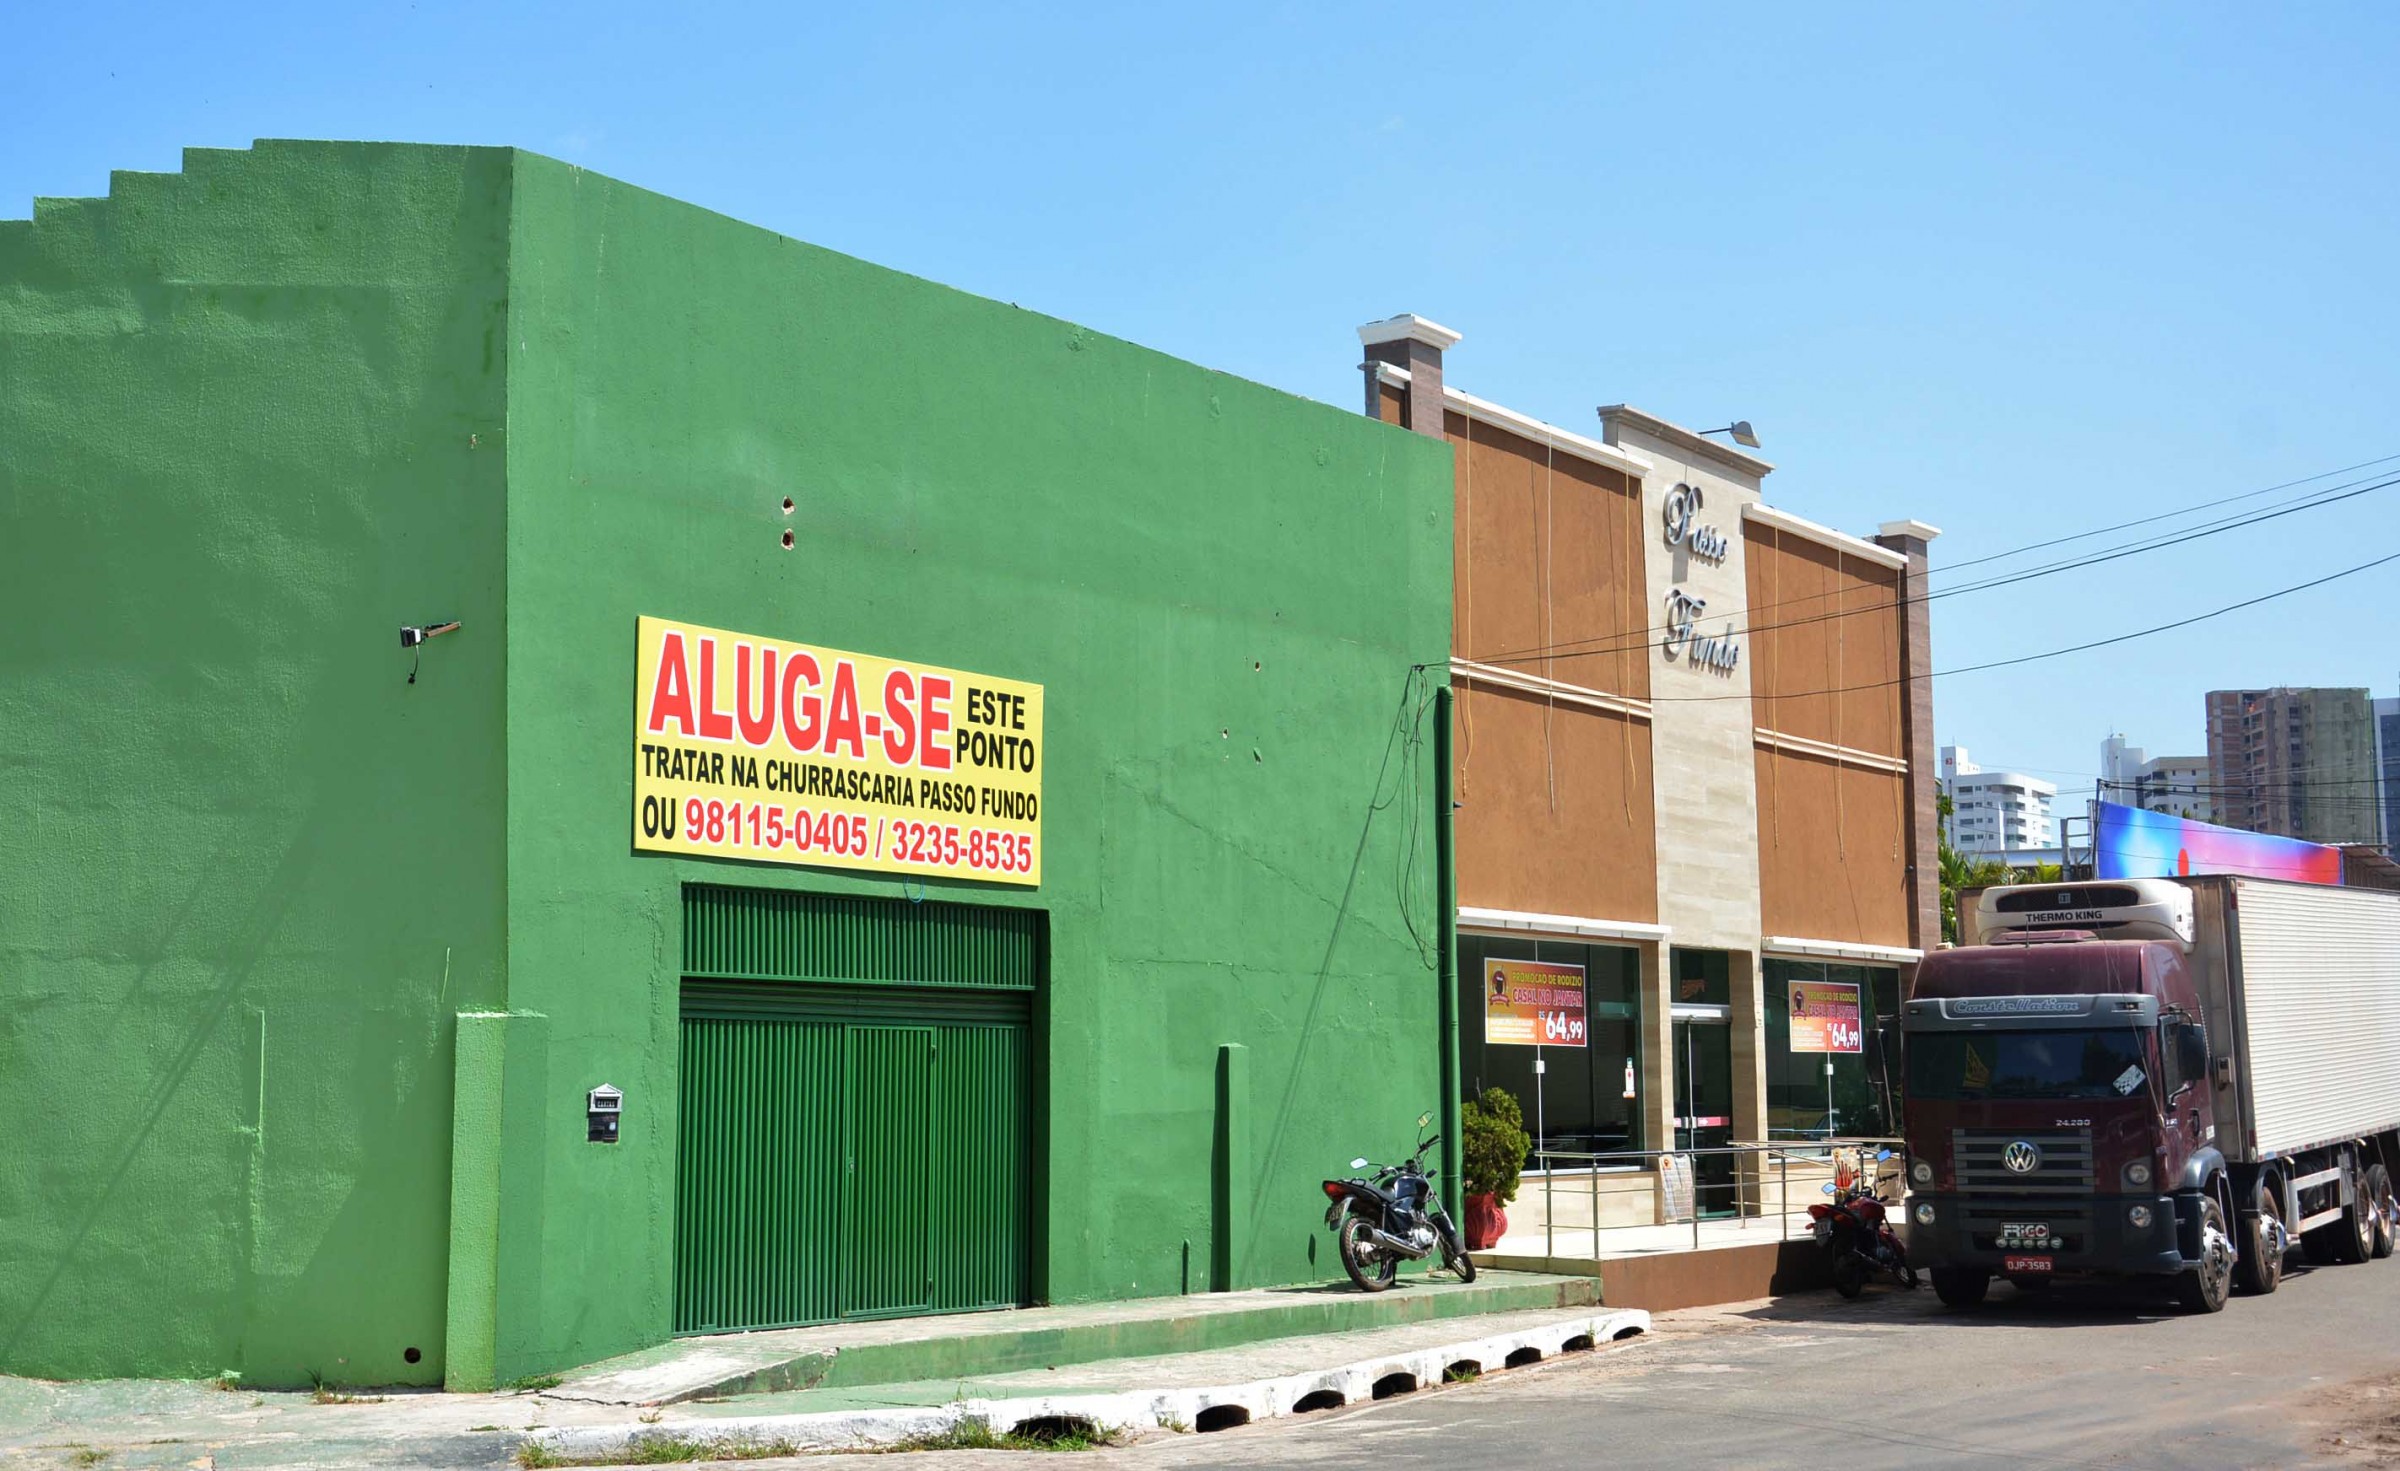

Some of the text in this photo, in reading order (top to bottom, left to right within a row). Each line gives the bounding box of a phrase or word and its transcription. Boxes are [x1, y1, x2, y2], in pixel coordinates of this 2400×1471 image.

[648, 633, 952, 770] ALUGA-SE
[967, 687, 1026, 730] ESTE
[956, 728, 1035, 774] PONTO
[641, 744, 1038, 823] TRATAR NA CHURRASCARIA PASSO FUNDO
[642, 795, 1033, 874] OU 98115-0405 / 3235-8535
[2025, 910, 2103, 923] THERMO KING
[1548, 974, 1557, 985] DE
[1512, 986, 1537, 1005] CASAL
[1537, 987, 1552, 1006] NO
[1953, 998, 2080, 1014] Constellation
[1545, 1010, 1583, 1042] 64,99
[1832, 1022, 1859, 1049] 64,99
